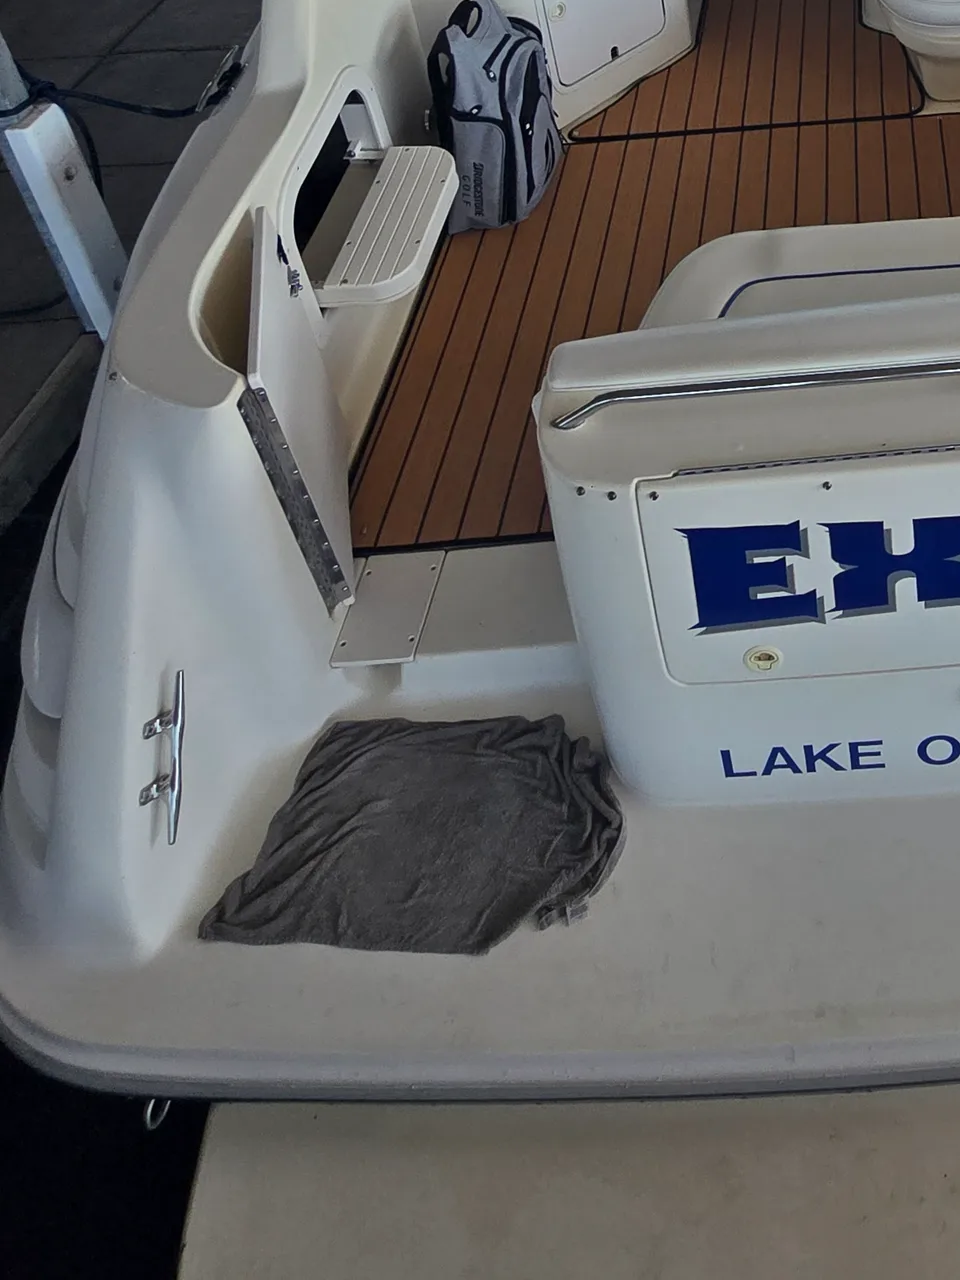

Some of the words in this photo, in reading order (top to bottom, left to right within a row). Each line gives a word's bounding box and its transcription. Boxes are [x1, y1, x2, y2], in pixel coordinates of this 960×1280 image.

[462, 174, 472, 208] GOLF
[472, 161, 485, 217] BRIDGESTONE
[719, 739, 887, 779] LAKE
